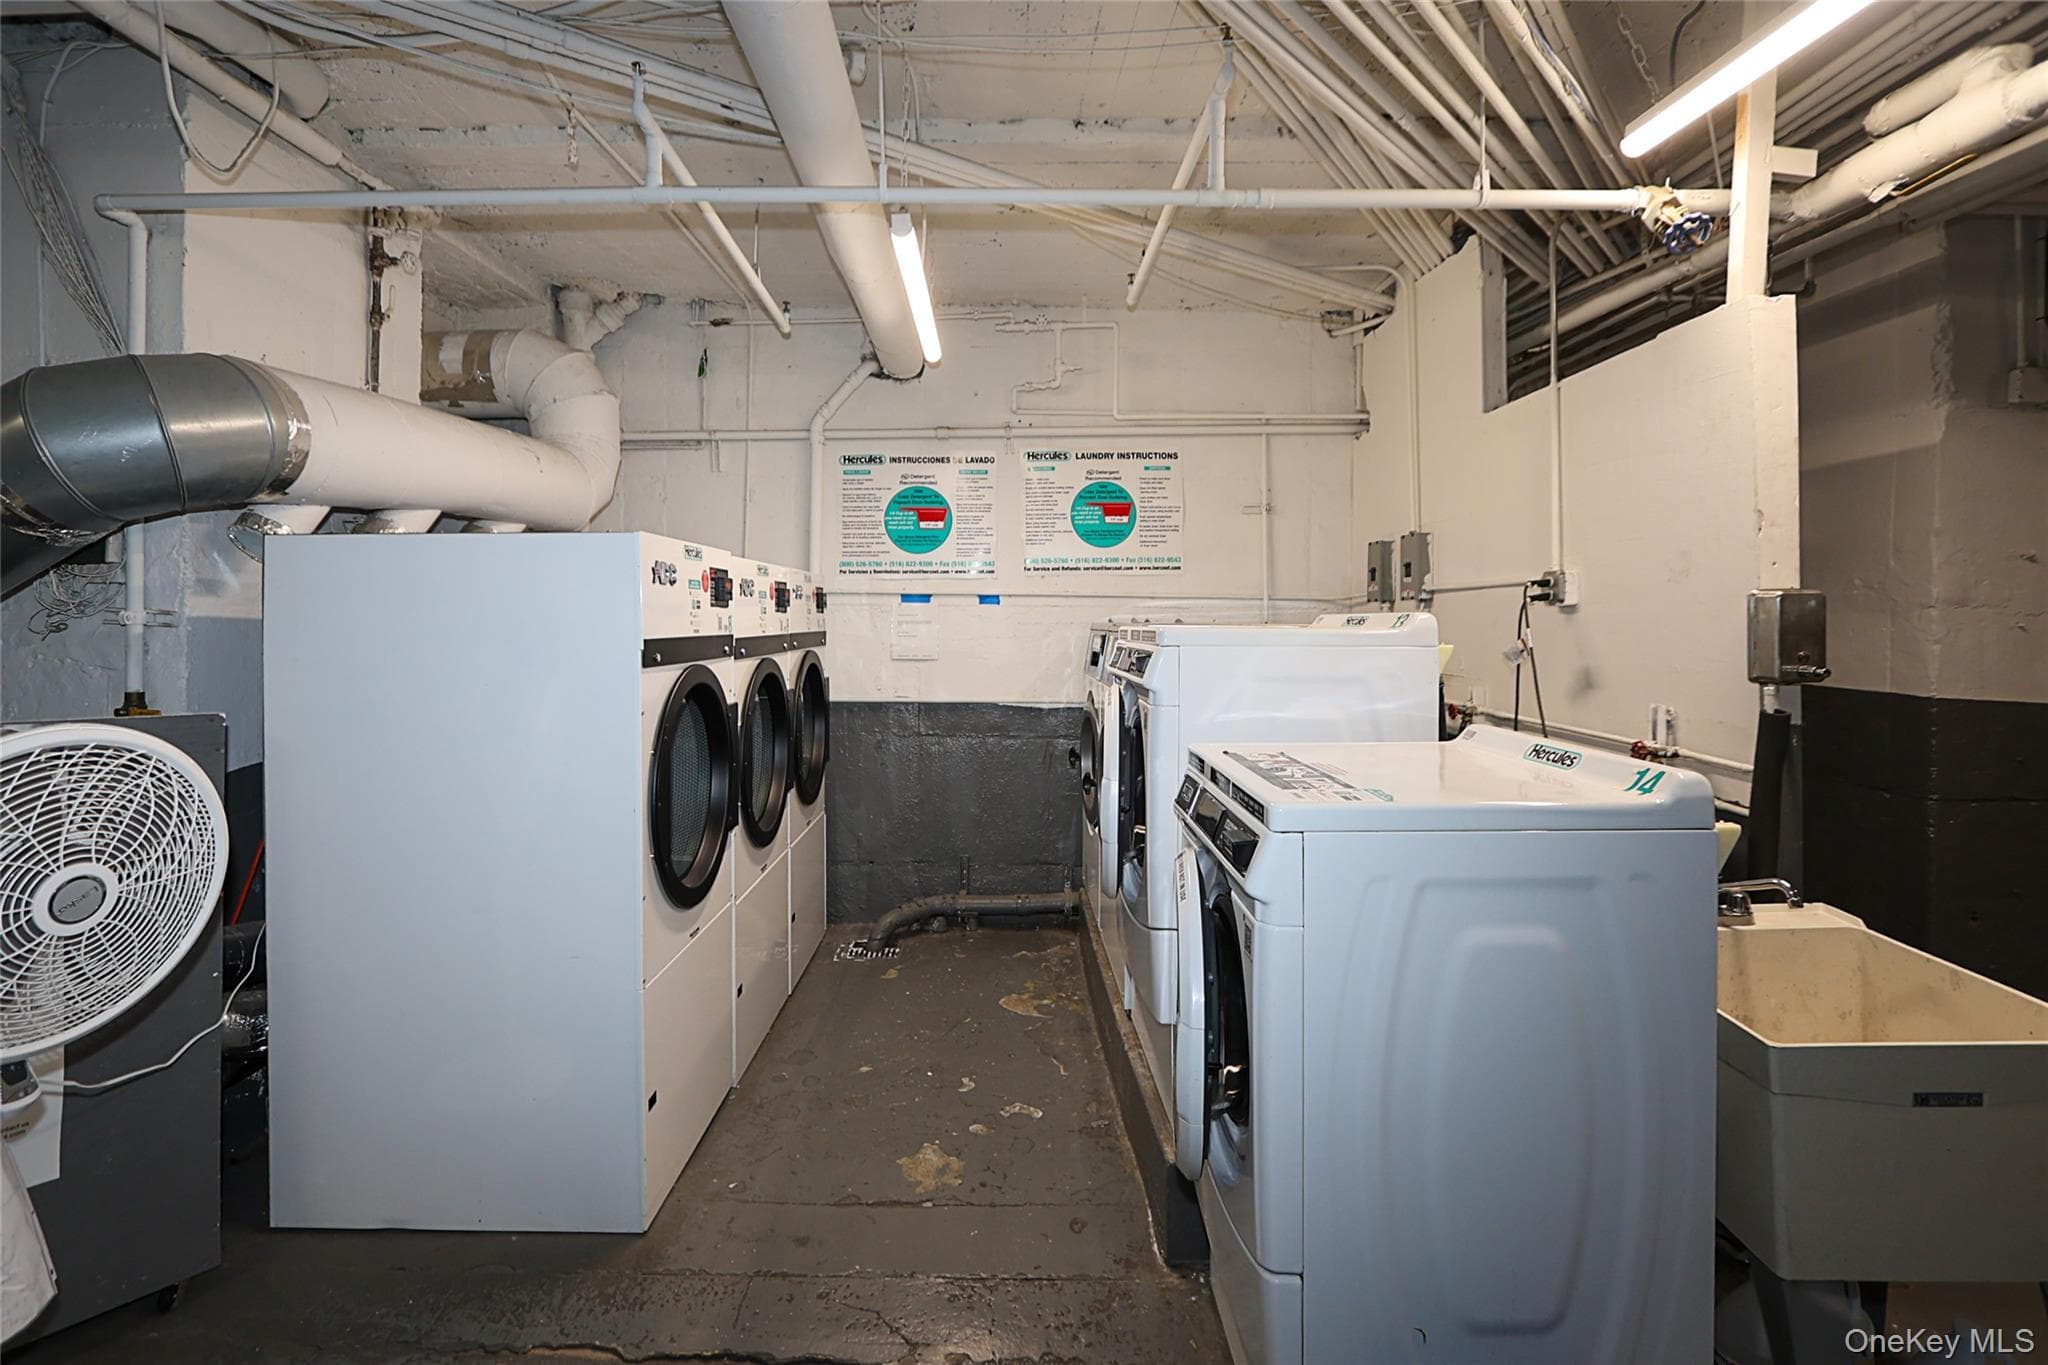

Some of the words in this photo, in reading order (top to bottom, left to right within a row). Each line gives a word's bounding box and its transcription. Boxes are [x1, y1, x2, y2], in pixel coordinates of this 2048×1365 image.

[843, 455, 883, 464] Hercules
[889, 456, 950, 464] INSTRUCCIONES
[965, 456, 995, 464] LAVADO
[1027, 452, 1068, 460] Hercules
[1075, 452, 1114, 460] LAUNDRY
[1117, 452, 1178, 460] INSTRUCTIONS
[1528, 744, 1577, 767] Hercules
[1624, 768, 1666, 795] 14
